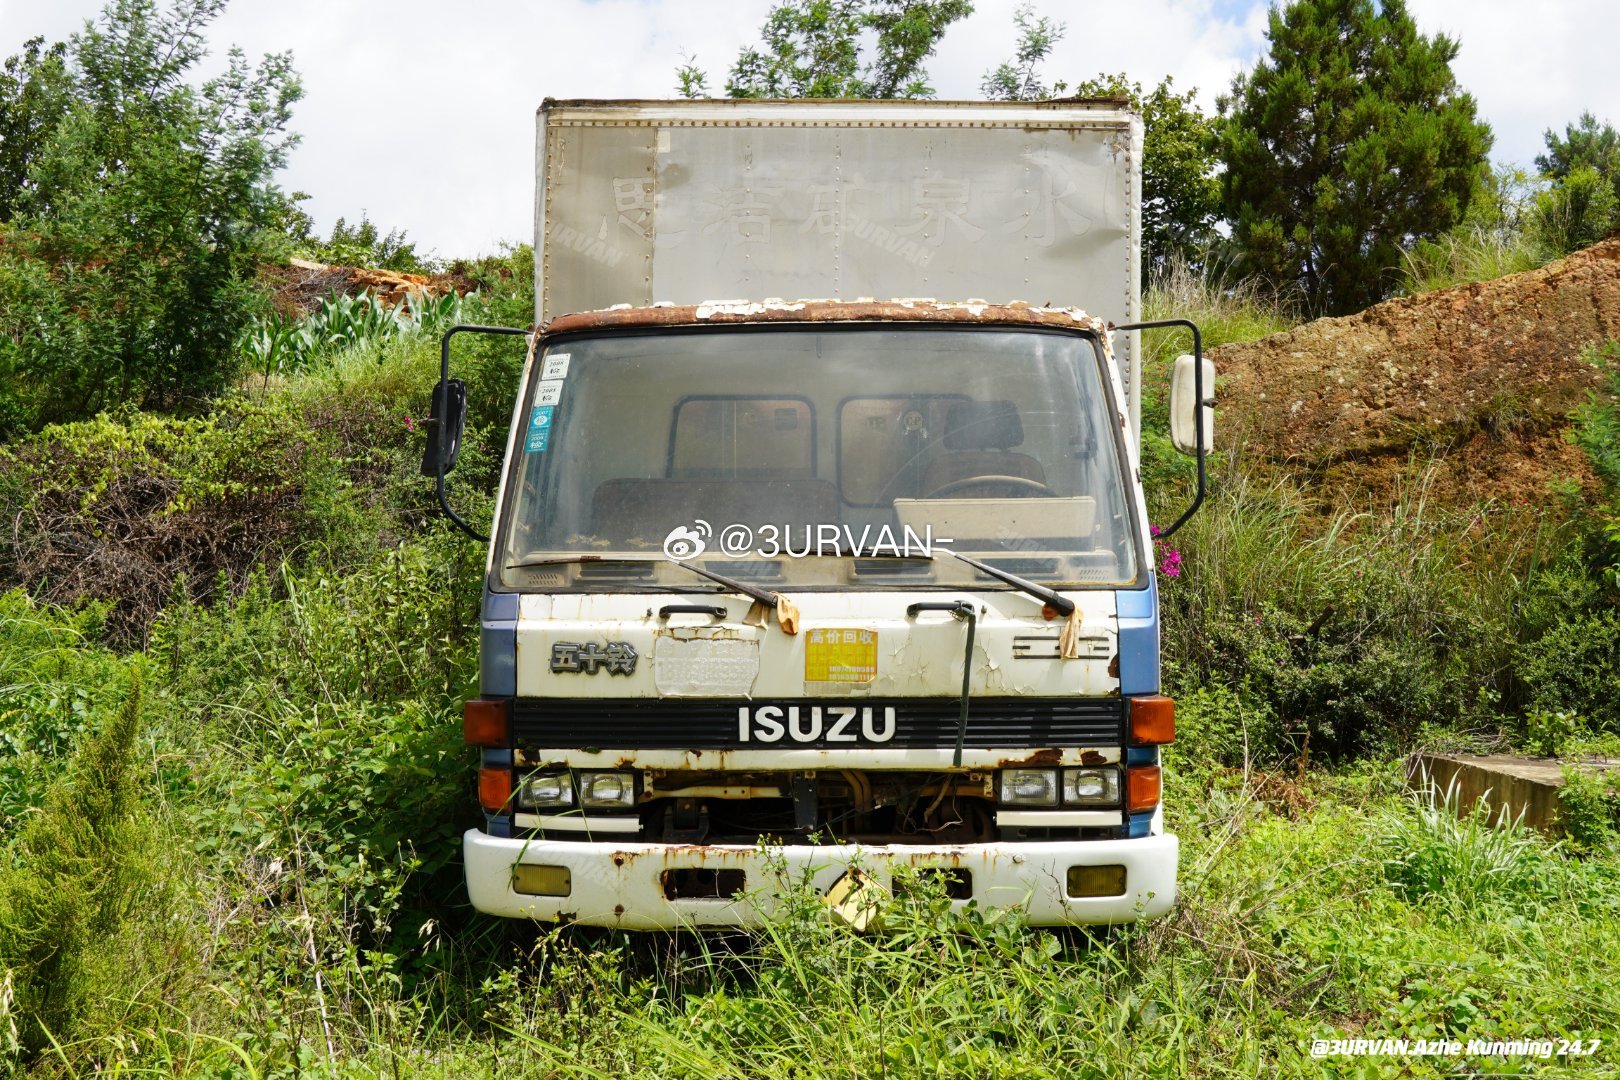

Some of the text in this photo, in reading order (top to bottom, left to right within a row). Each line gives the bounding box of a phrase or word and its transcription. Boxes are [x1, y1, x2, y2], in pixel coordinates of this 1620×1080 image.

[810, 629, 873, 644] 高价回收
[551, 642, 638, 675] 五十铃
[738, 706, 896, 743] ISUZU
